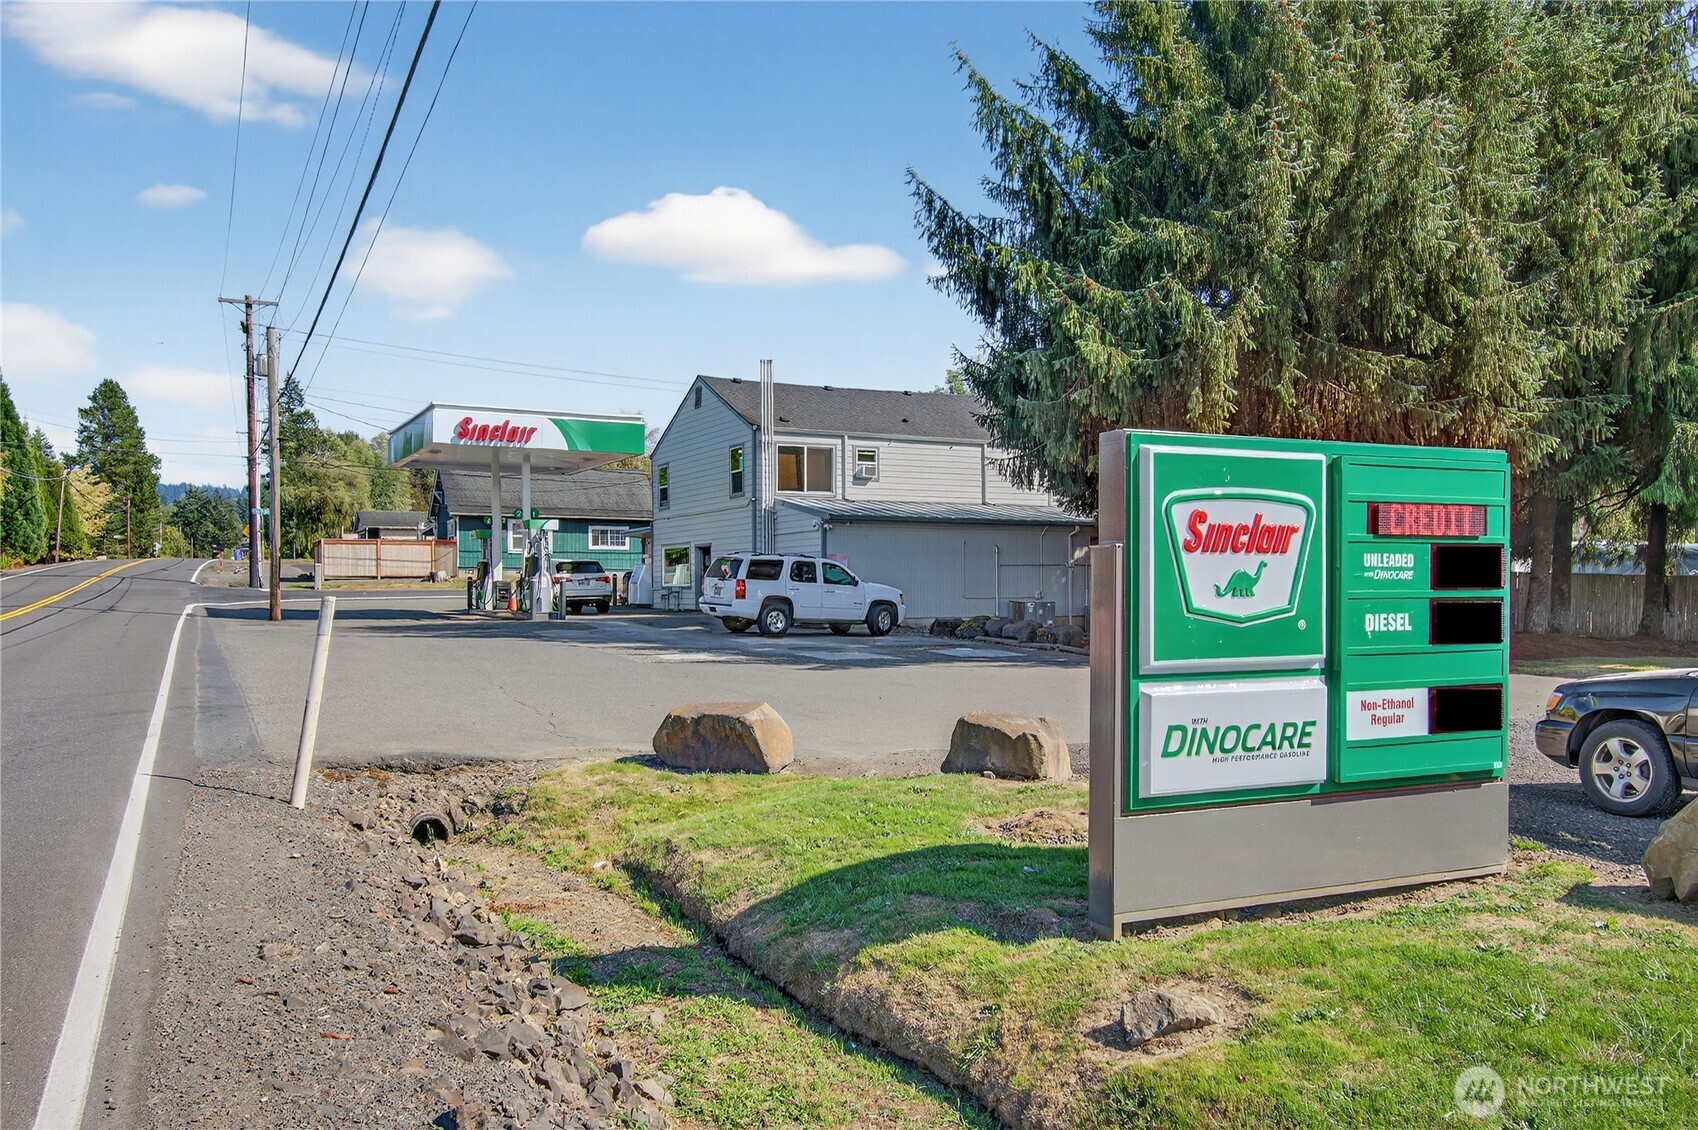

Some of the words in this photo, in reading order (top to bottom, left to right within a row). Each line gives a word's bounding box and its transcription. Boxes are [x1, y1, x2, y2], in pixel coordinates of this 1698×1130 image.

[457, 417, 537, 444] Sinclair
[1390, 503, 1473, 536] CREDIT
[1183, 508, 1300, 554] Sinclair
[1363, 552, 1415, 567] UNLEADED
[1373, 569, 1414, 580] DINOCARE
[1365, 613, 1412, 632] DIESEL
[1360, 697, 1415, 712] Non-Ethanol
[1191, 717, 1209, 725] WITH
[1370, 713, 1405, 727] Regular
[1160, 720, 1317, 758] DINOCARE
